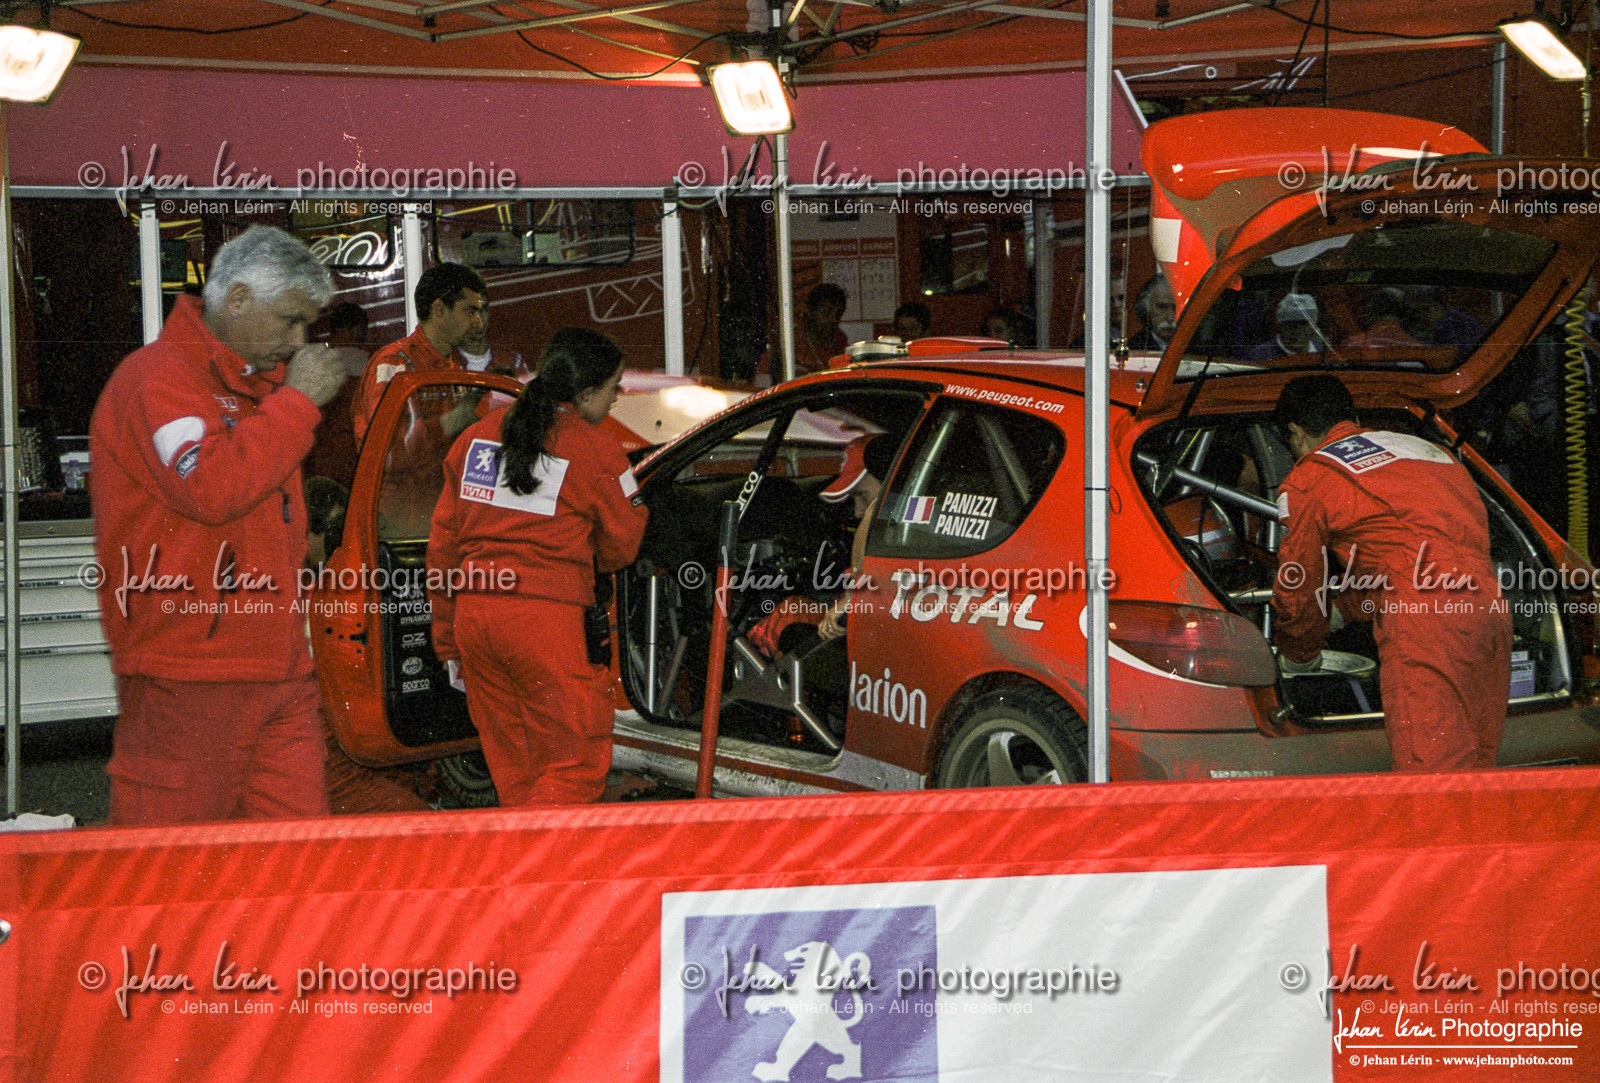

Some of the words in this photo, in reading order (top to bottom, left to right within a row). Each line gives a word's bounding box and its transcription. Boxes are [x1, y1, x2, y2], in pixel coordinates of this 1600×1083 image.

[945, 383, 1065, 417] www.peugeot.com
[1343, 446, 1378, 460] PEUGEOT
[1354, 453, 1393, 468] TOTAL
[463, 485, 492, 500] TOTAL
[942, 491, 998, 519] PANIZZI
[934, 513, 990, 541] PANIZZI
[889, 571, 1045, 631] TOTAL
[402, 678, 430, 691] sparco
[849, 660, 927, 729] larion
